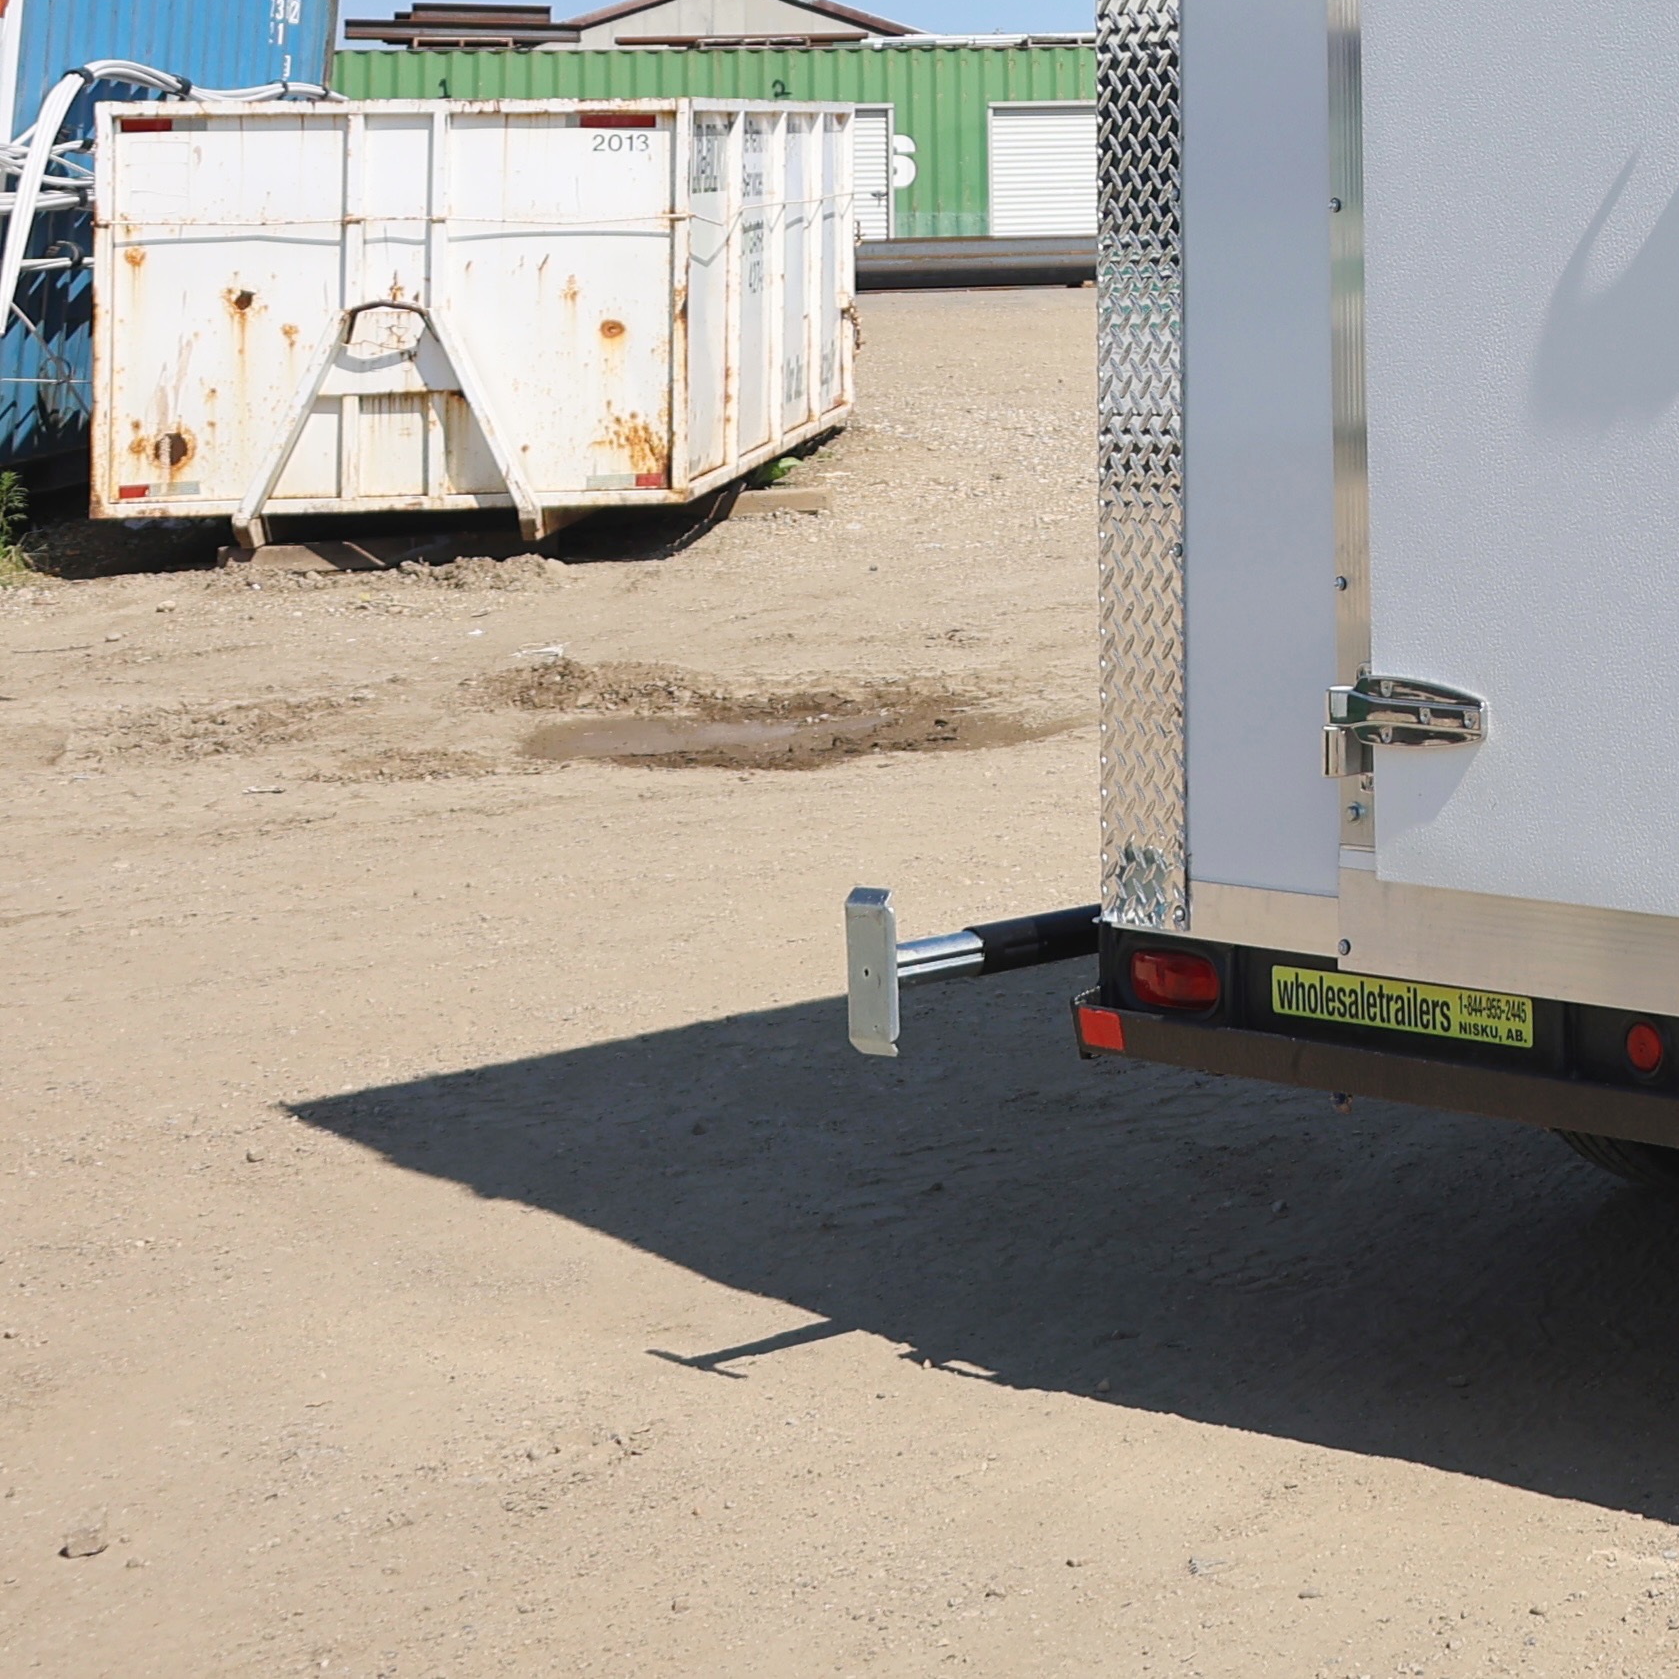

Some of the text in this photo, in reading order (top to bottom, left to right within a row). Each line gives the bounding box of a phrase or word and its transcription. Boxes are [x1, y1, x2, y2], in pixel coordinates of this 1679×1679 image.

[771, 79, 792, 98] 2
[592, 133, 650, 152] 2013
[1277, 971, 1527, 1033] wholesaletrailers 1-844-955-2445
[1458, 1020, 1528, 1044] NISKU, AB.
